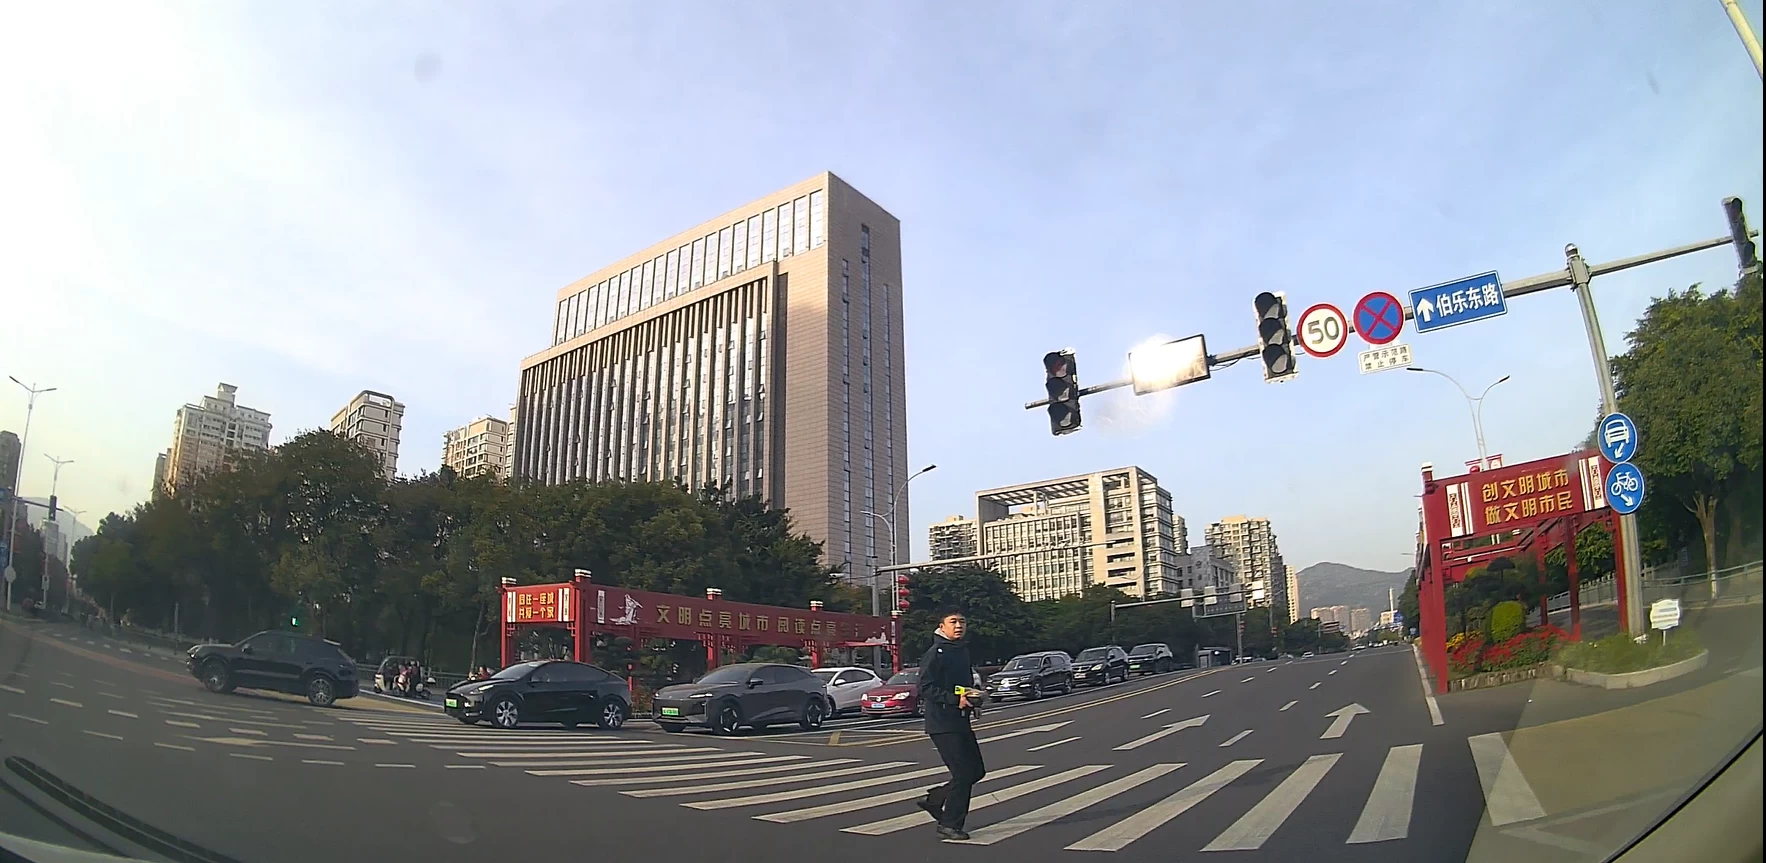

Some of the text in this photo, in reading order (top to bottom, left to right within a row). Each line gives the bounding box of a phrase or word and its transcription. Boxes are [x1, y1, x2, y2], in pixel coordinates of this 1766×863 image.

[1436, 282, 1499, 318] 伯乐东路
[1308, 316, 1340, 344] 50
[1365, 355, 1410, 370] 禁止停车
[1482, 469, 1568, 502] 创文明城市
[1485, 491, 1573, 525] 做文明市民
